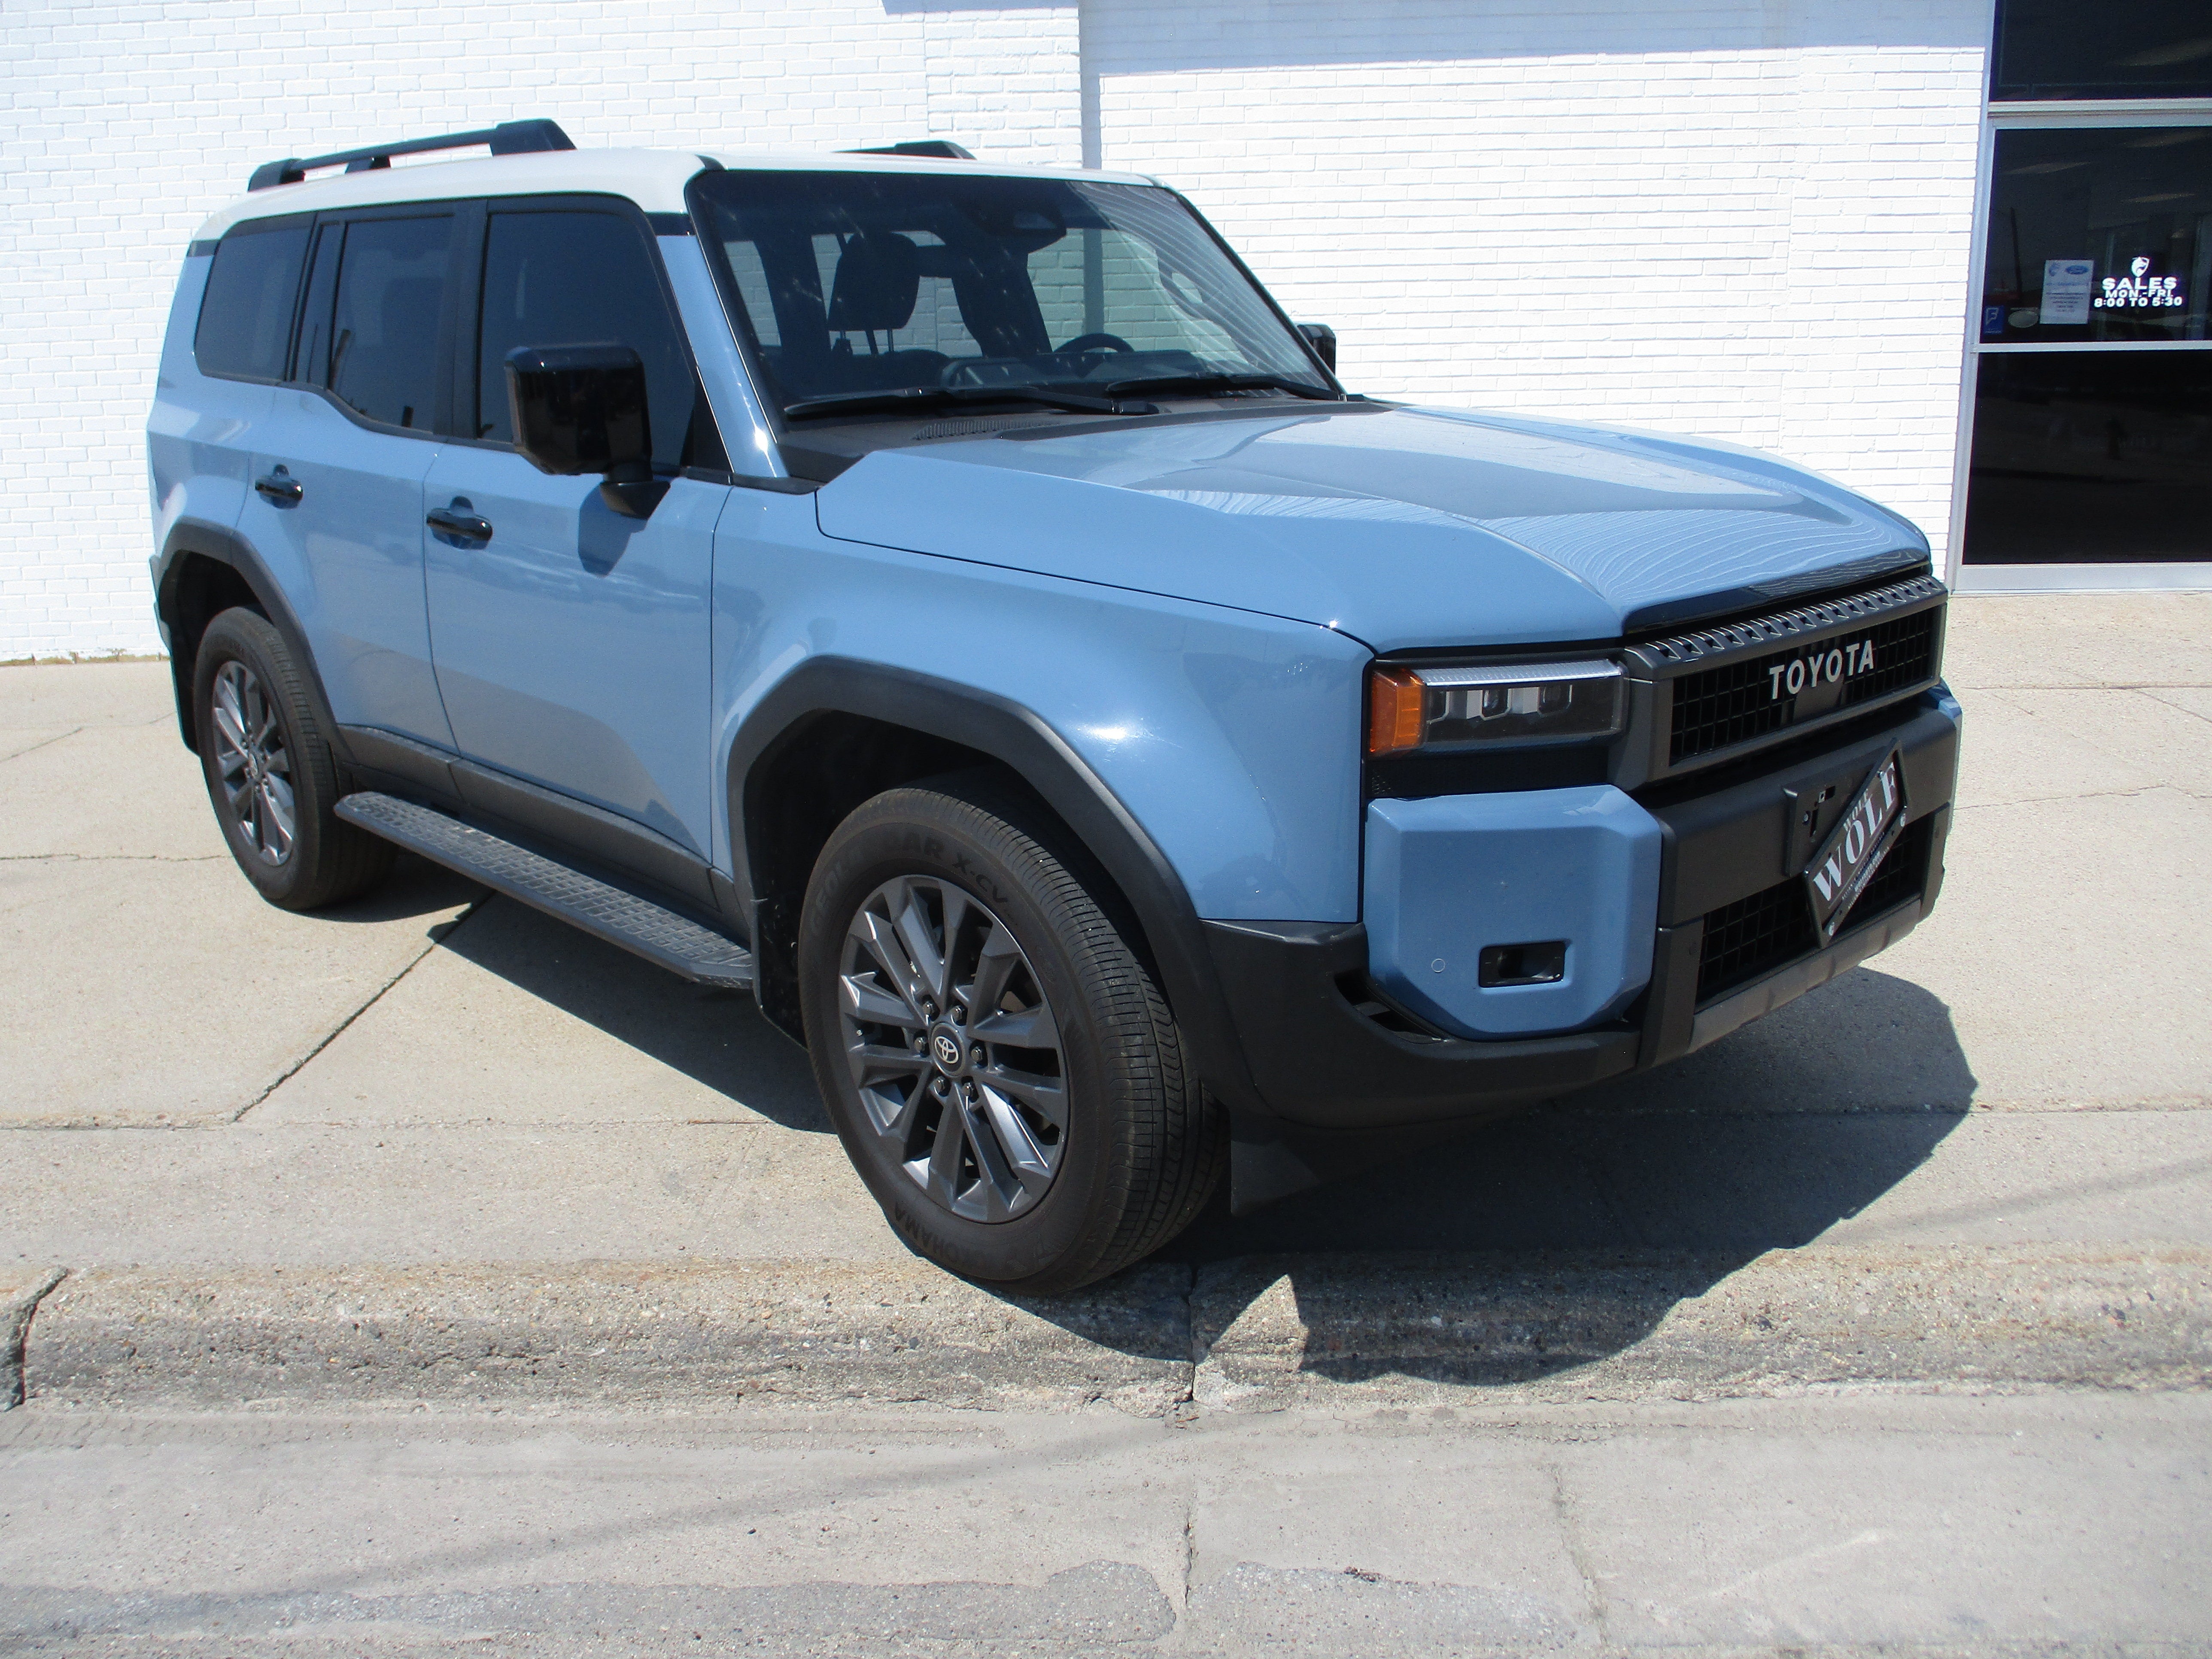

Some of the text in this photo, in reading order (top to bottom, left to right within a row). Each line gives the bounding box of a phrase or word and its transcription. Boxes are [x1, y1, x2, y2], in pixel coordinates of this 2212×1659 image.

[2094, 296, 2183, 308] 8:00 TO 5:30
[2102, 277, 2177, 290] SALES
[1769, 639, 1874, 700] TOYOTA
[1813, 762, 1896, 901] WOLF
[1843, 788, 1869, 832] WOLF
[952, 852, 1009, 903] X-CV
